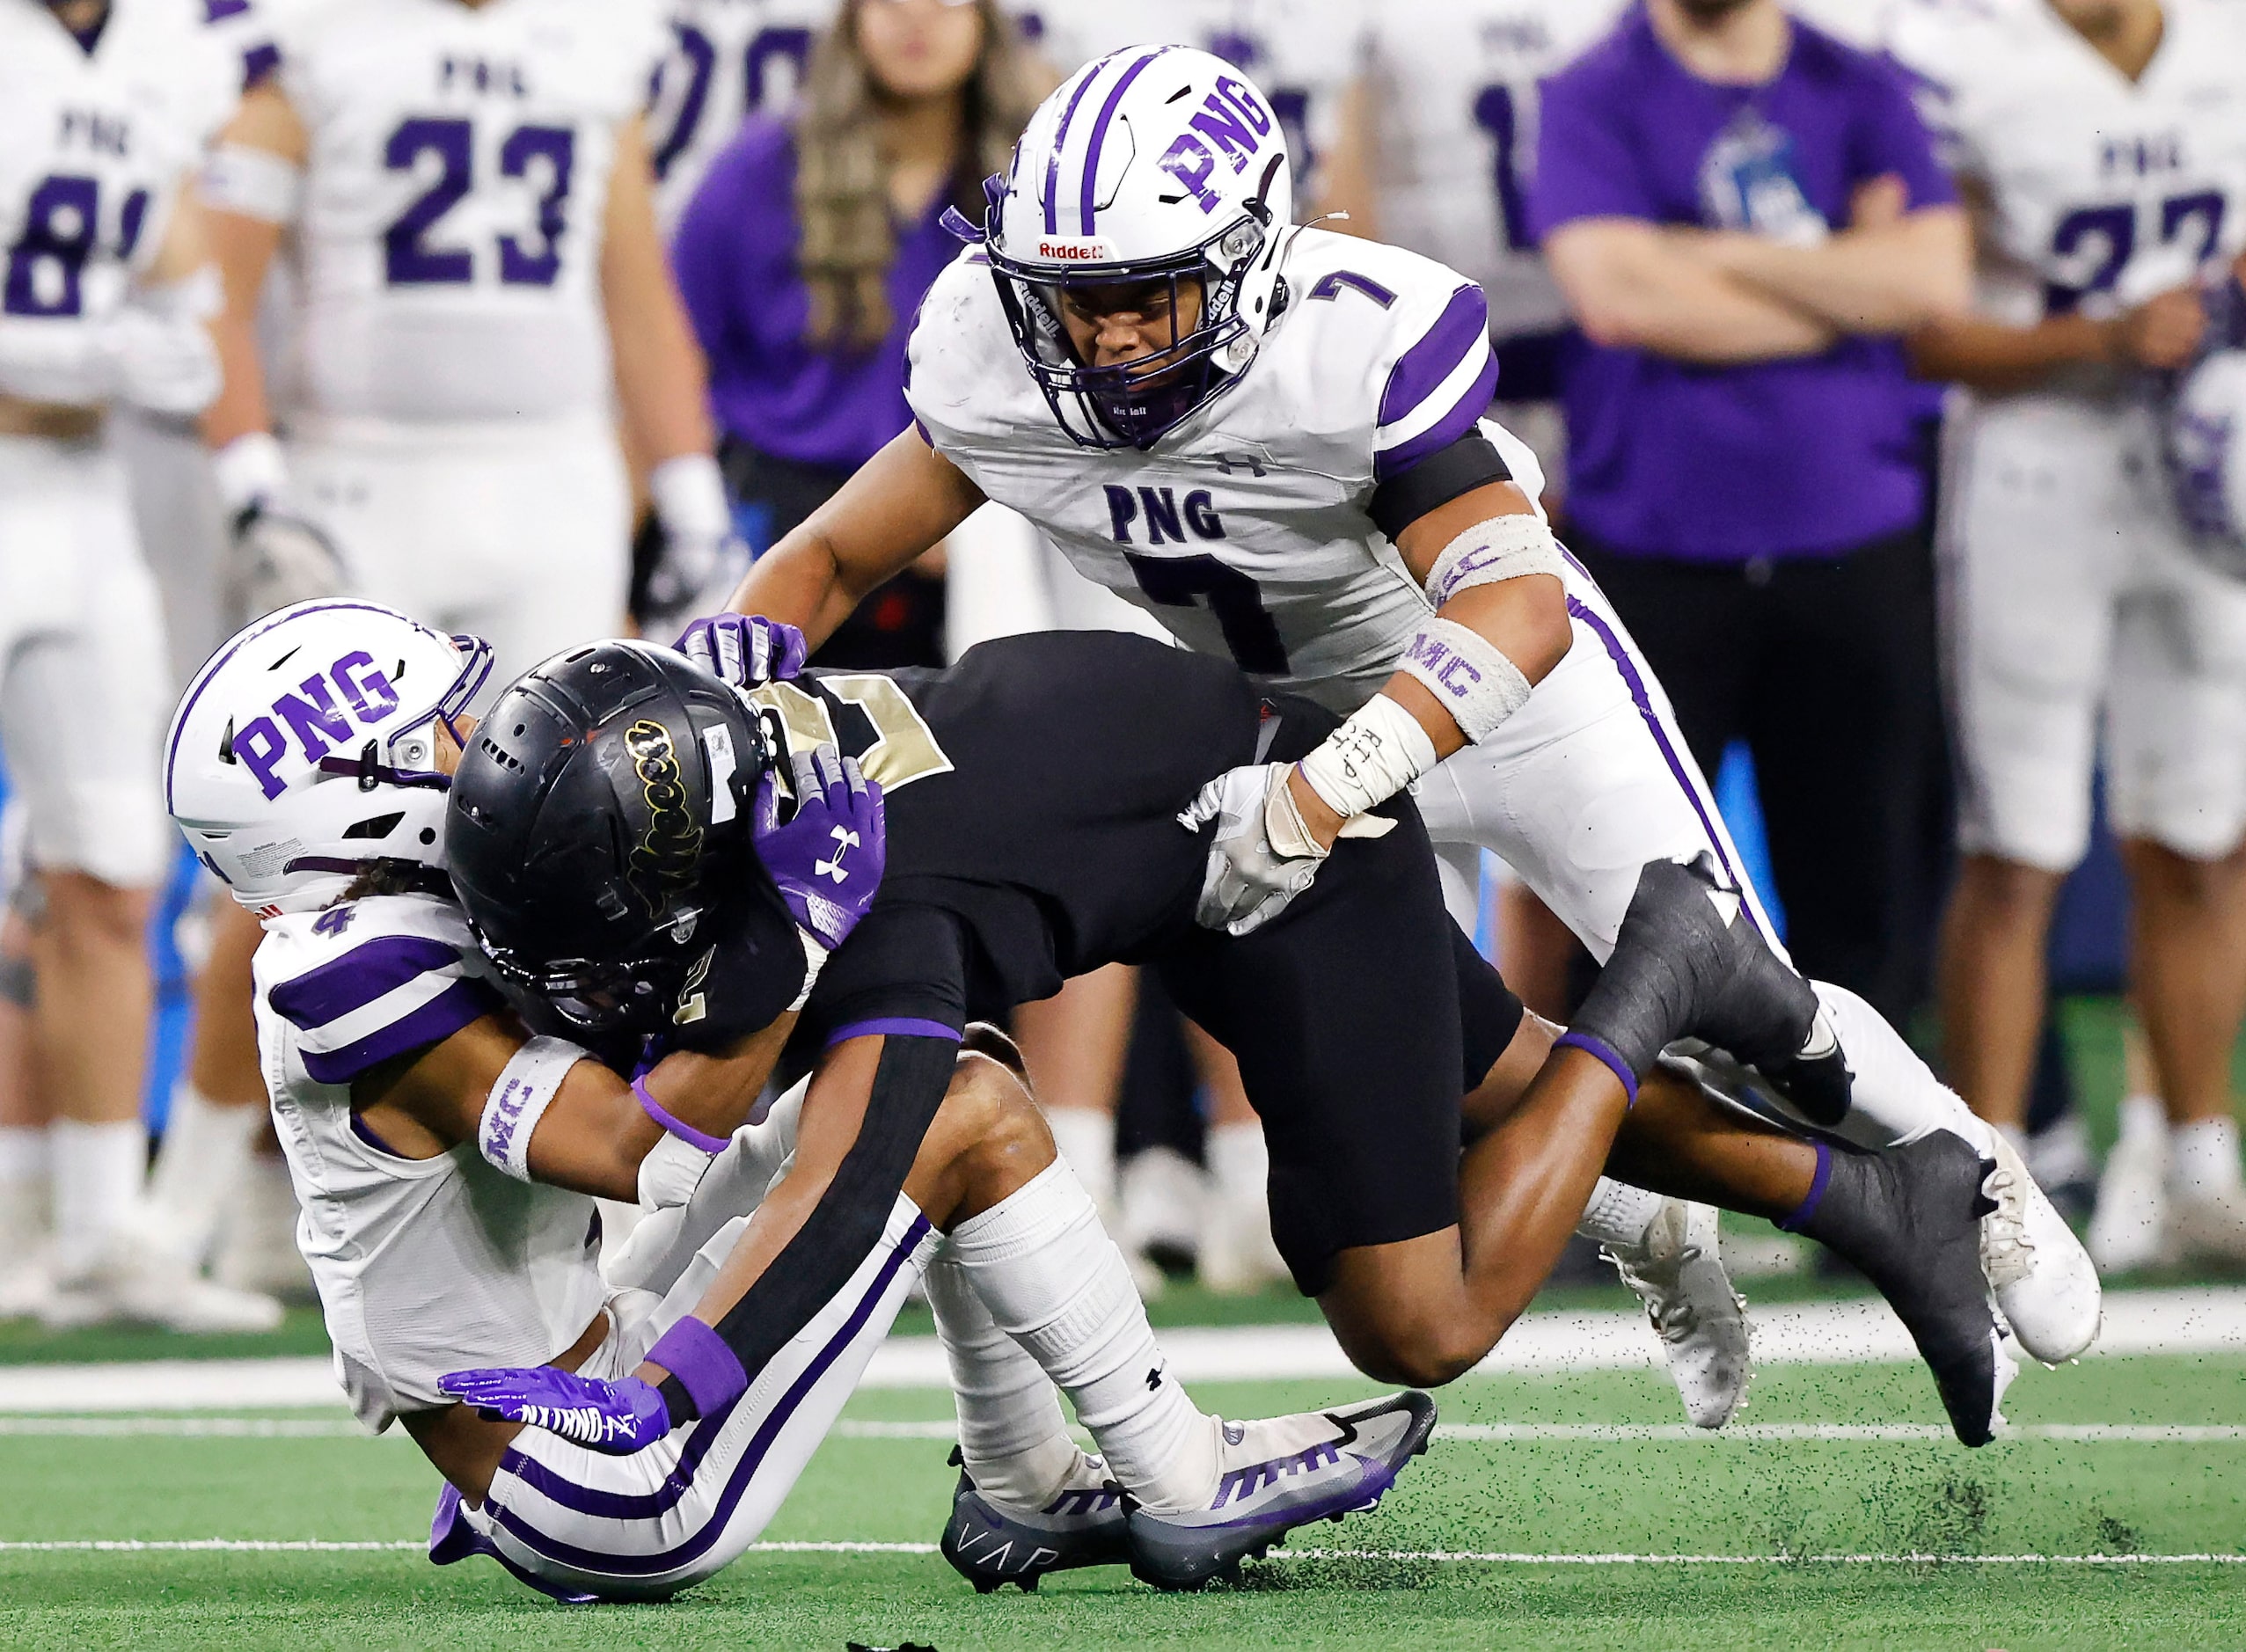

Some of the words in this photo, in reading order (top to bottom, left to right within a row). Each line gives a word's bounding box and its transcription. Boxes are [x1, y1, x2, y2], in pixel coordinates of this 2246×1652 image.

[1157, 75, 1270, 215] PNG
[385, 117, 574, 283] 23
[1306, 270, 1398, 311] 7
[1103, 483, 1226, 545] PNG
[1121, 551, 1291, 676] 7
[1407, 632, 1482, 698] MC
[231, 649, 400, 801] PNG
[311, 907, 357, 939] 4
[487, 1078, 534, 1166] MC
